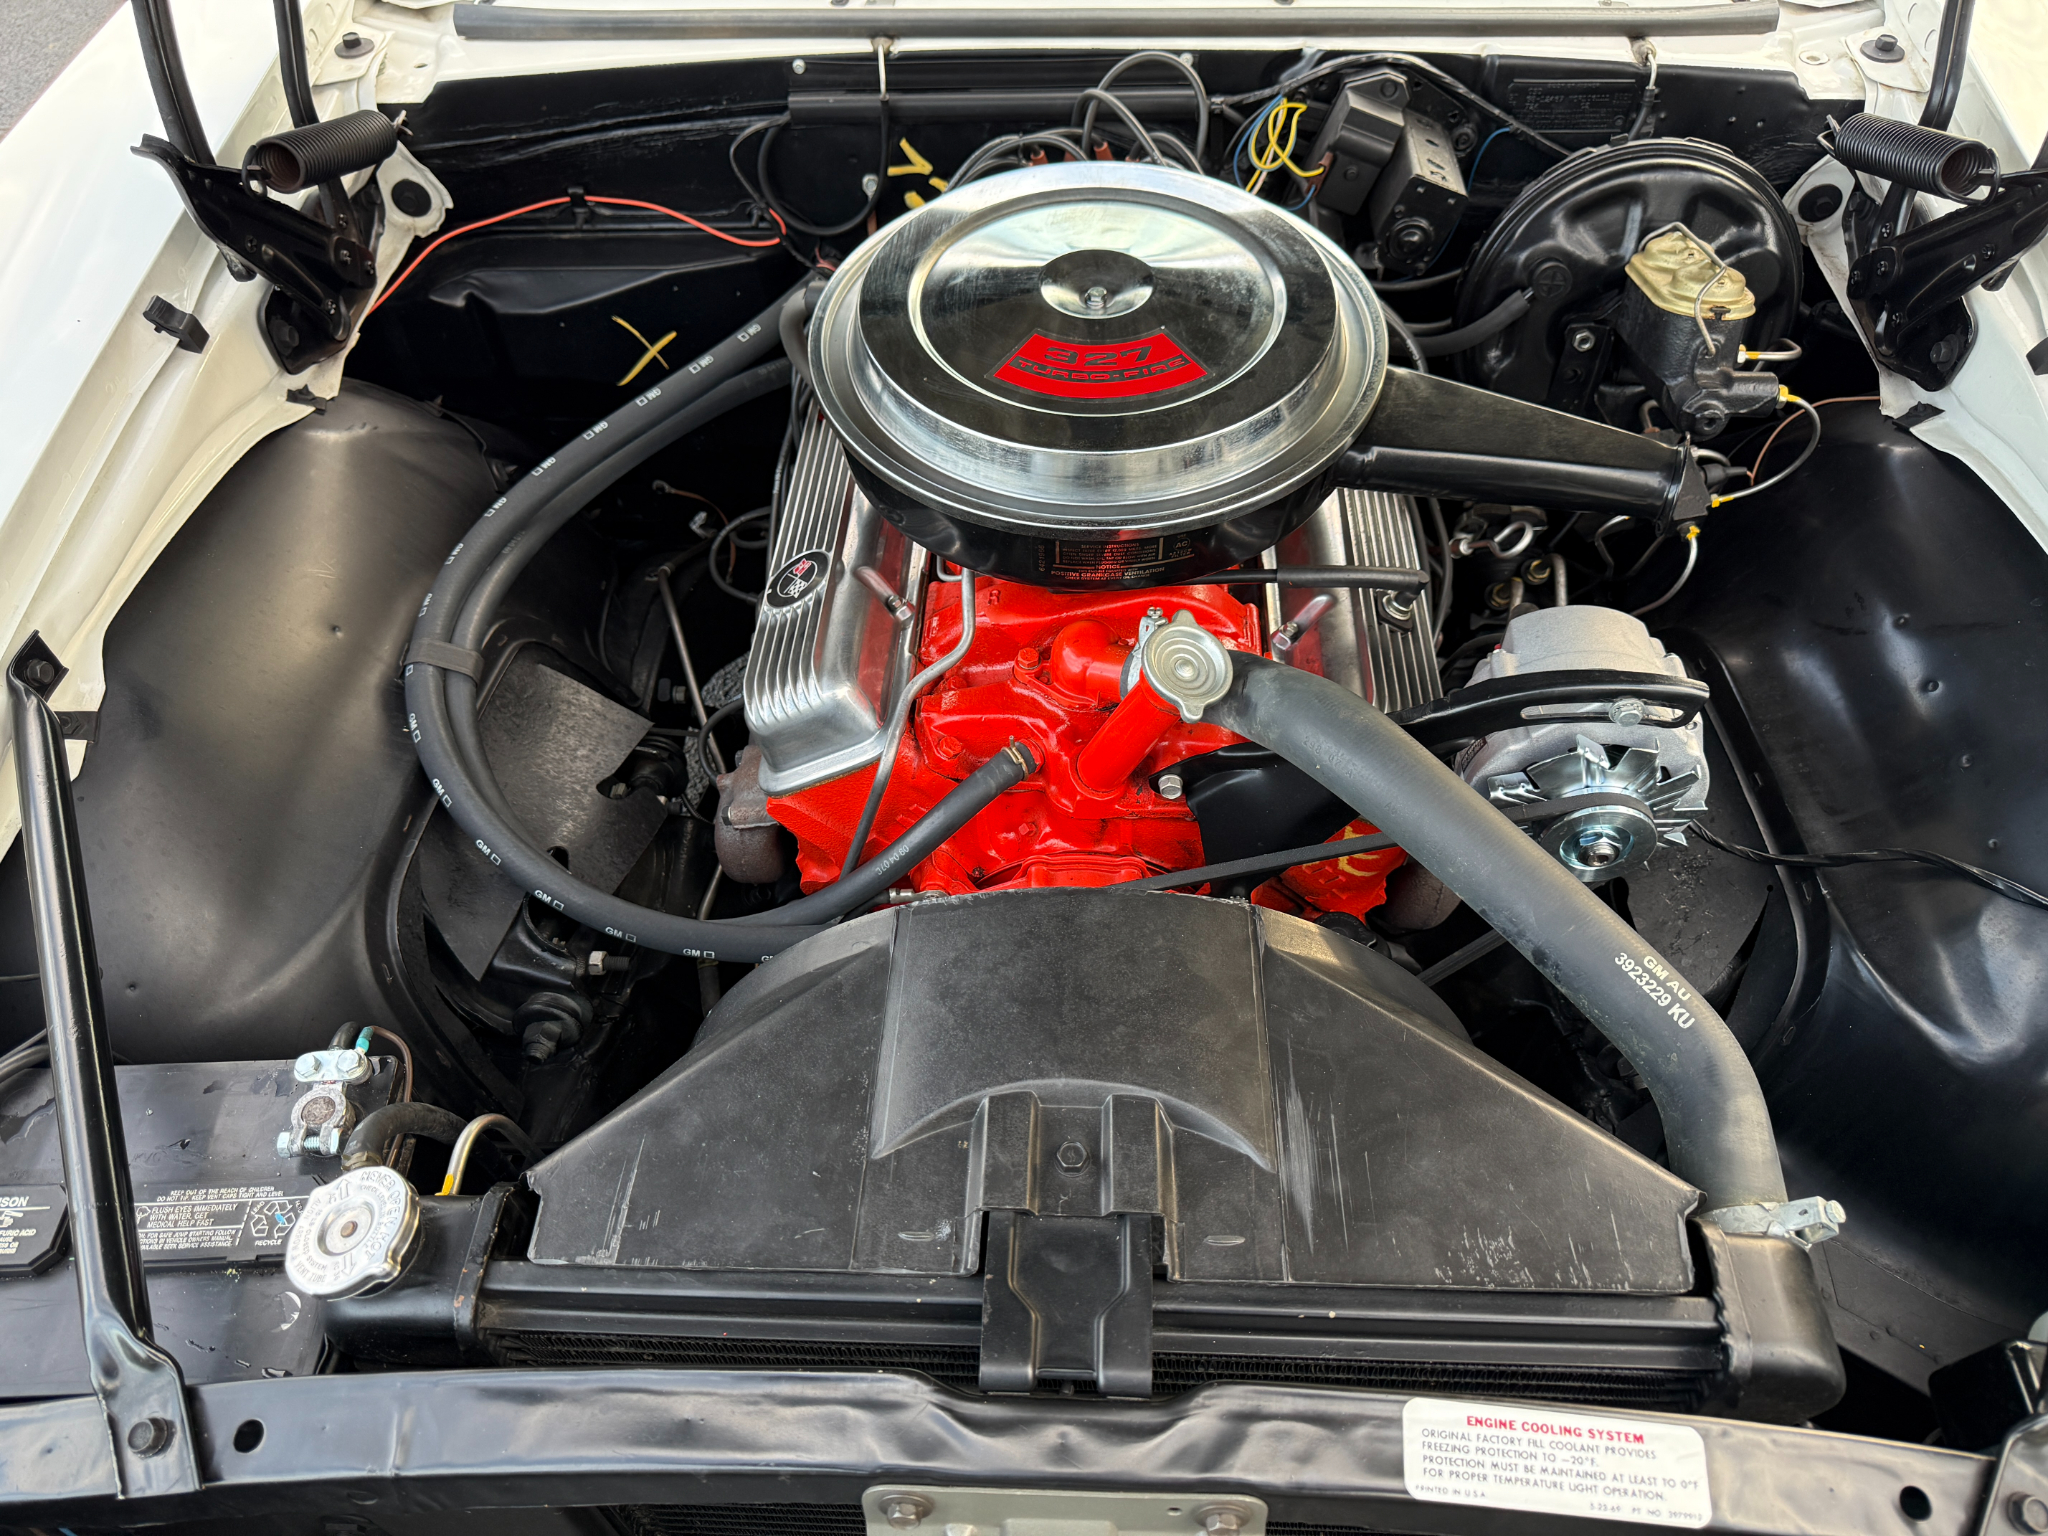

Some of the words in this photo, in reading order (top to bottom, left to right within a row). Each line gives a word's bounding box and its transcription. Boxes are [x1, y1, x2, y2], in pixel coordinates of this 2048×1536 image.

[1044, 346, 1152, 367] 327
[1018, 358, 1186, 381] TURBO-FIRE
[1124, 567, 1165, 576] VENTILATION
[476, 839, 491, 856] GM
[534, 889, 552, 904] GM
[605, 926, 623, 938] GM
[683, 948, 701, 958] GM
[1643, 955, 1669, 981] GM
[1665, 980, 1692, 1001] AU
[1614, 952, 1672, 1007] 3923229
[1667, 1002, 1695, 1029] KU
[361, 1170, 396, 1191] NEVER
[0, 1196, 30, 1207] SON
[151, 1206, 174, 1214] FLUSH
[174, 1205, 193, 1213] EYES
[193, 1203, 238, 1212] IMMEDIATELY
[250, 1200, 265, 1215] LEAD
[385, 1190, 401, 1228] OPEN
[147, 1220, 175, 1228] MEDICAL
[177, 1219, 196, 1227] HELP
[196, 1218, 214, 1226] FAST
[149, 1213, 167, 1221] WITH
[19, 1228, 37, 1237] ACID
[364, 1231, 390, 1261] HOT
[295, 1260, 311, 1279] VENT
[309, 1273, 328, 1284] TUBE
[306, 1255, 328, 1271] SYSTEM
[1466, 1415, 1517, 1430] ENGINE
[1521, 1421, 1582, 1438] COOLING
[1588, 1428, 1645, 1445] SYSTEM
[1421, 1428, 1472, 1442] ORIGINAL
[1476, 1433, 1522, 1446] FACTORY
[1527, 1438, 1546, 1449] FILL
[1549, 1440, 1600, 1453] COOLANT
[1604, 1446, 1656, 1460] PROVIDES
[1422, 1441, 1470, 1454] FREEZING
[1475, 1446, 1538, 1460] PROTECTION
[1542, 1452, 1556, 1463] TO
[1422, 1454, 1485, 1469] PROTECTION
[1491, 1460, 1518, 1472] MUST
[1523, 1464, 1535, 1474] BE
[1540, 1466, 1606, 1481] MAINTAINED
[1611, 1473, 1624, 1483] AT
[1628, 1474, 1657, 1487] LEAST
[1662, 1478, 1677, 1488] TO
[1423, 1467, 1443, 1478] FOR
[1449, 1470, 1489, 1482] PROPER
[1494, 1474, 1565, 1490] TEMPERATURE
[1569, 1482, 1598, 1494] LIGHT
[1415, 1484, 1448, 1494] PRINTED
[1453, 1488, 1461, 1496] IN
